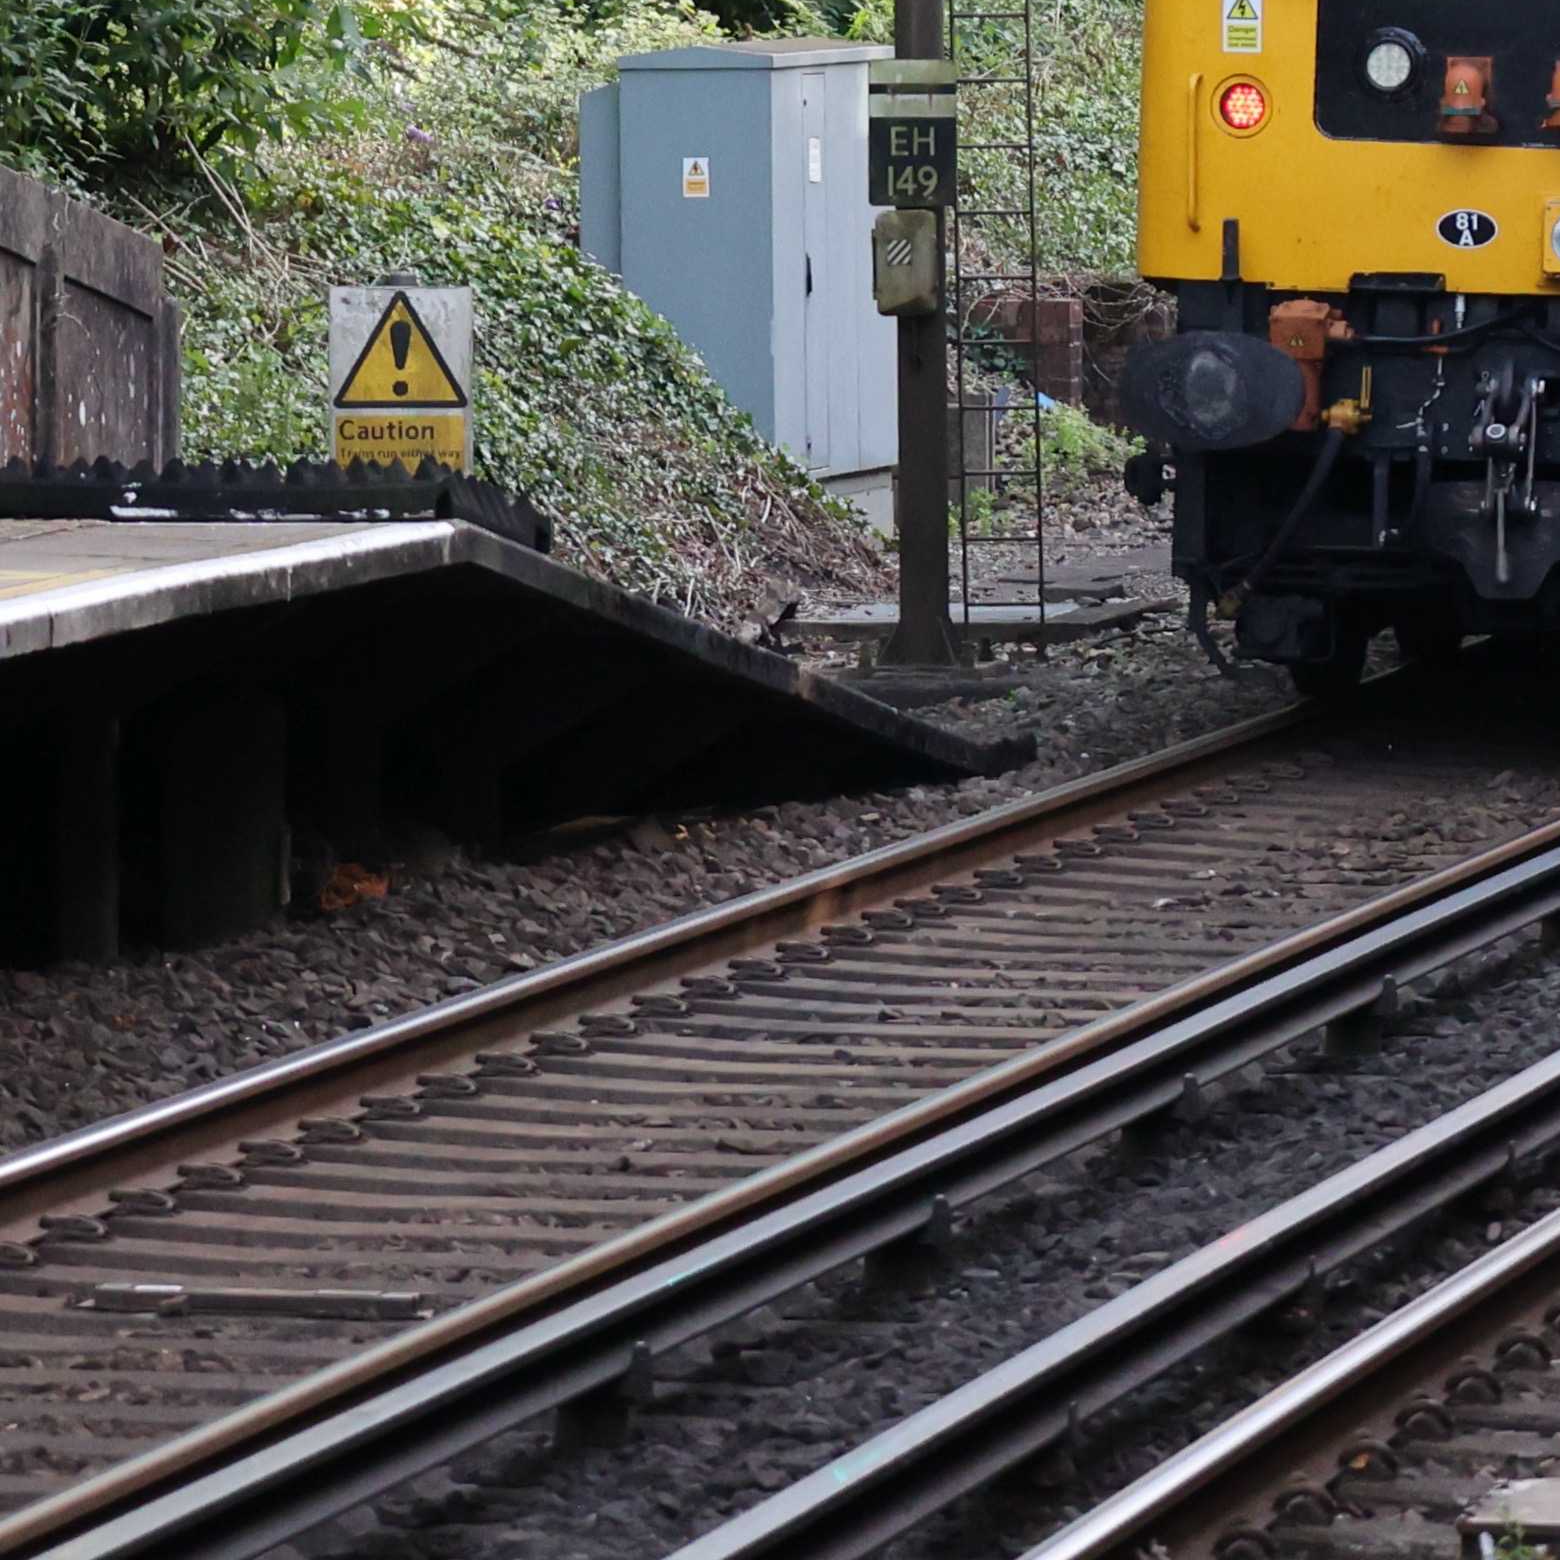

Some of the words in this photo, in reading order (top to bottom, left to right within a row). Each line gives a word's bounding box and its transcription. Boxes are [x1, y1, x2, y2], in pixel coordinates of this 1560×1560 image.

[890, 126, 935, 156] EH
[887, 165, 938, 197] 149
[1456, 212, 1478, 230] 81
[1459, 229, 1474, 246] A
[339, 420, 435, 440] Caution
[378, 449, 398, 458] run
[438, 449, 460, 459] way
